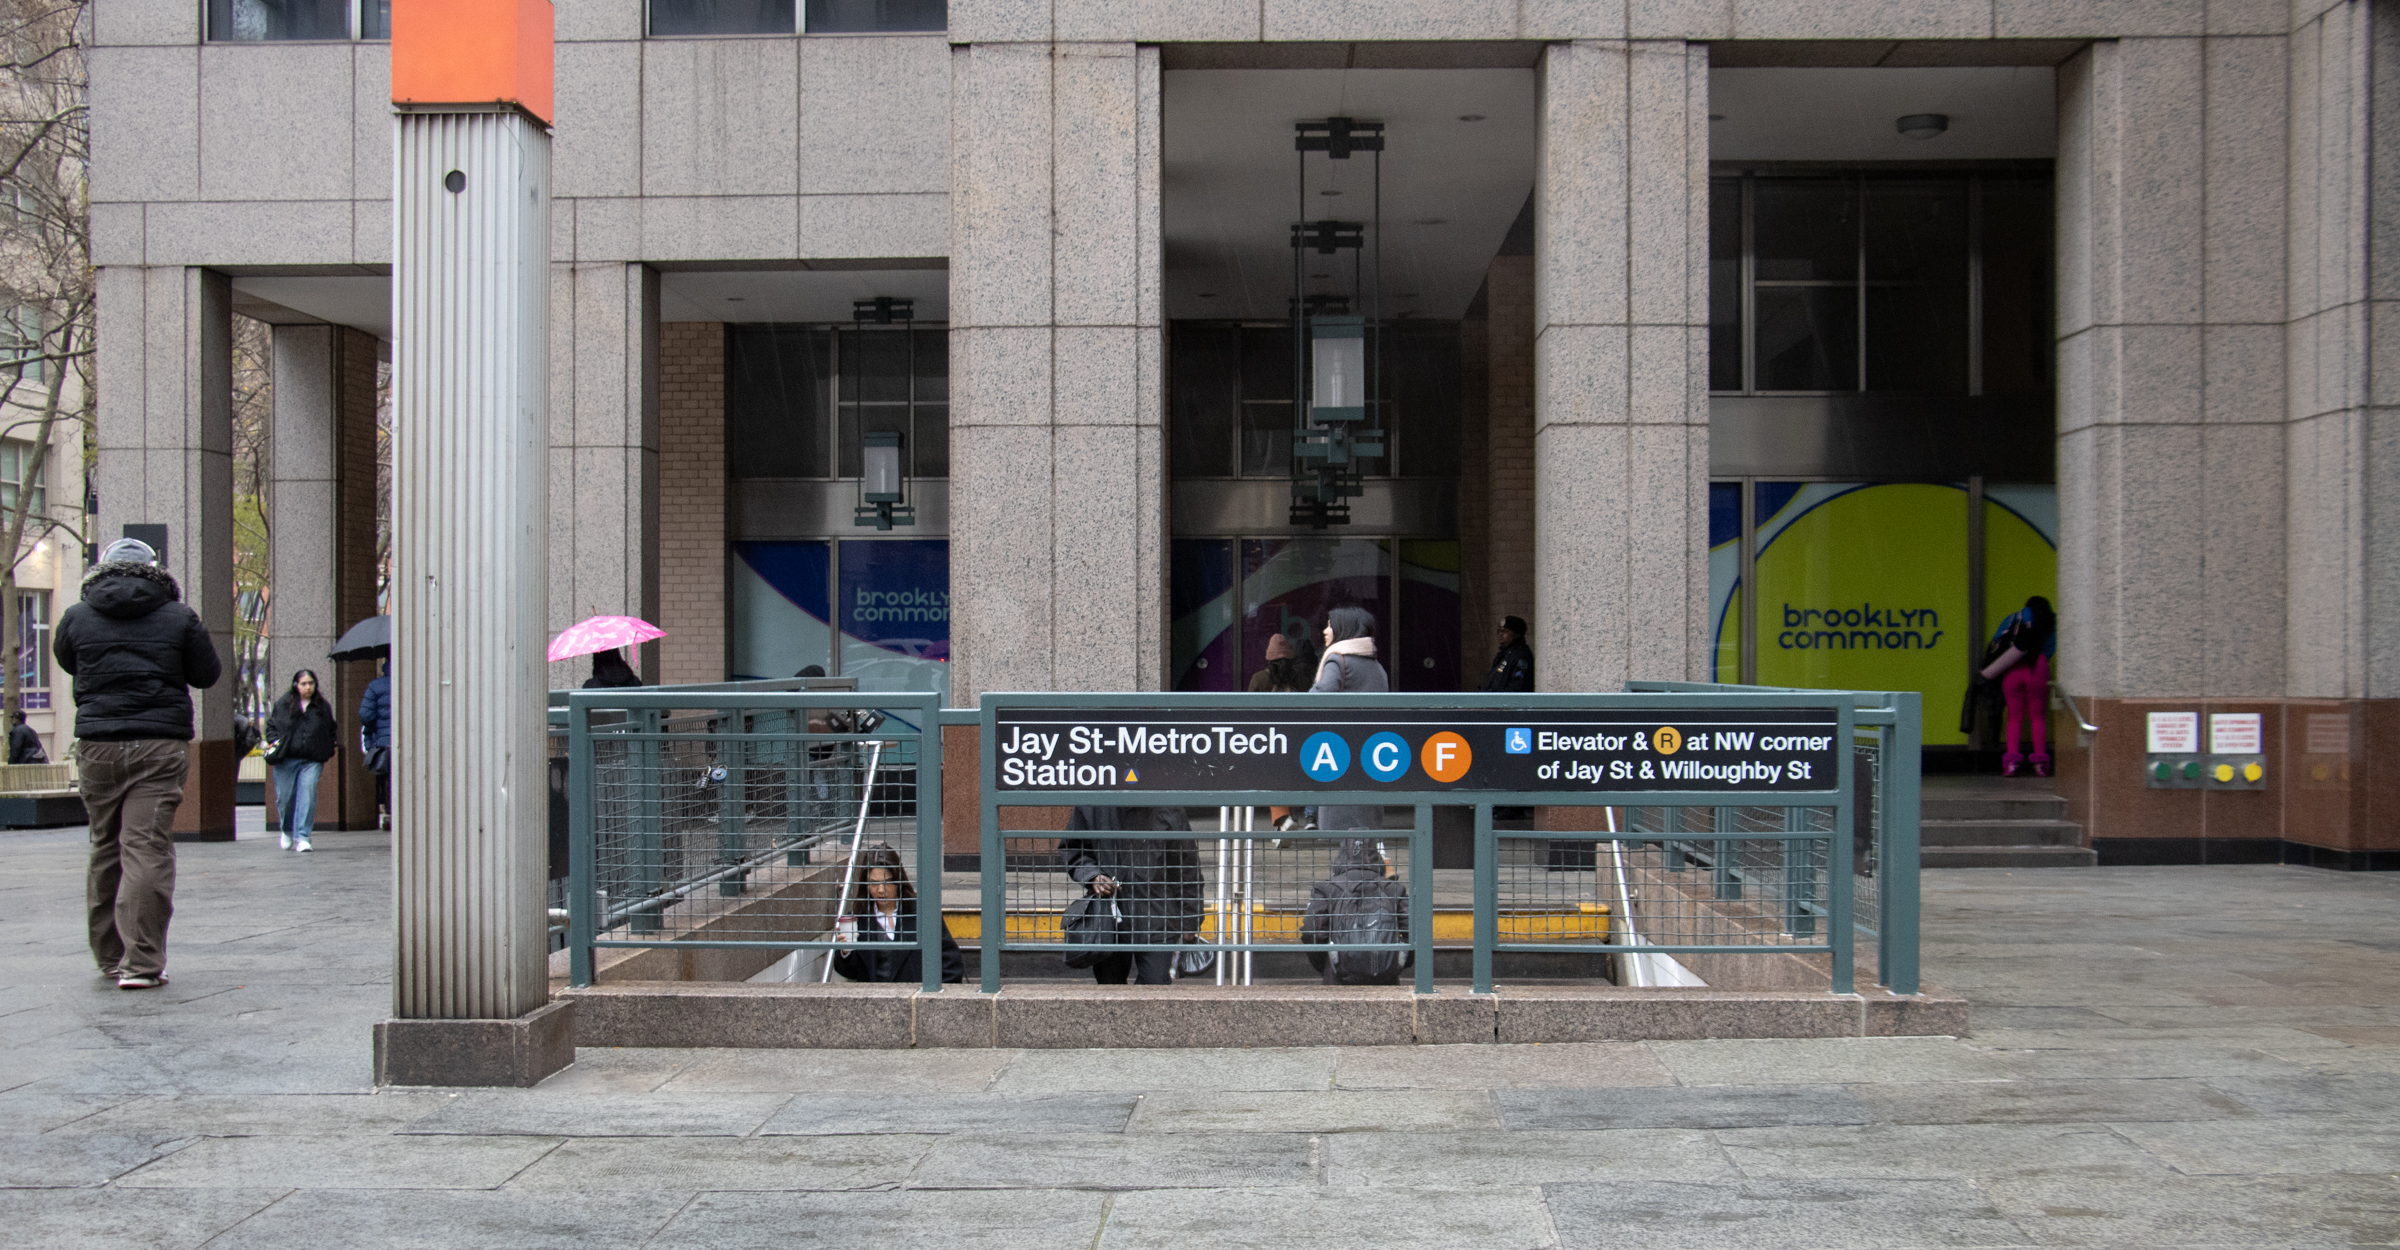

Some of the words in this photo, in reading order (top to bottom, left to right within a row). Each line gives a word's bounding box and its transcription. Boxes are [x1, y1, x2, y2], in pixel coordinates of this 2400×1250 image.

[853, 607, 950, 622] commo
[1778, 631, 1944, 649] commons
[1002, 727, 1059, 760] Jay
[1069, 726, 1288, 754] St-MetroTech
[1538, 732, 1628, 751] Elevator
[1633, 732, 1649, 751] &
[1661, 733, 1674, 749] R
[1687, 733, 1709, 751] at
[1715, 732, 1755, 751] NW
[1760, 736, 1832, 751] corner
[1311, 742, 1339, 771] A
[1372, 742, 1399, 772] C
[1436, 743, 1457, 771] F
[1002, 758, 1117, 786] Station
[1538, 760, 1560, 780] of
[1564, 760, 1604, 785] Jay
[1609, 760, 1634, 780] St
[1639, 760, 1656, 780] &
[1660, 760, 1782, 785] Willoughby
[1787, 760, 1812, 780] St
